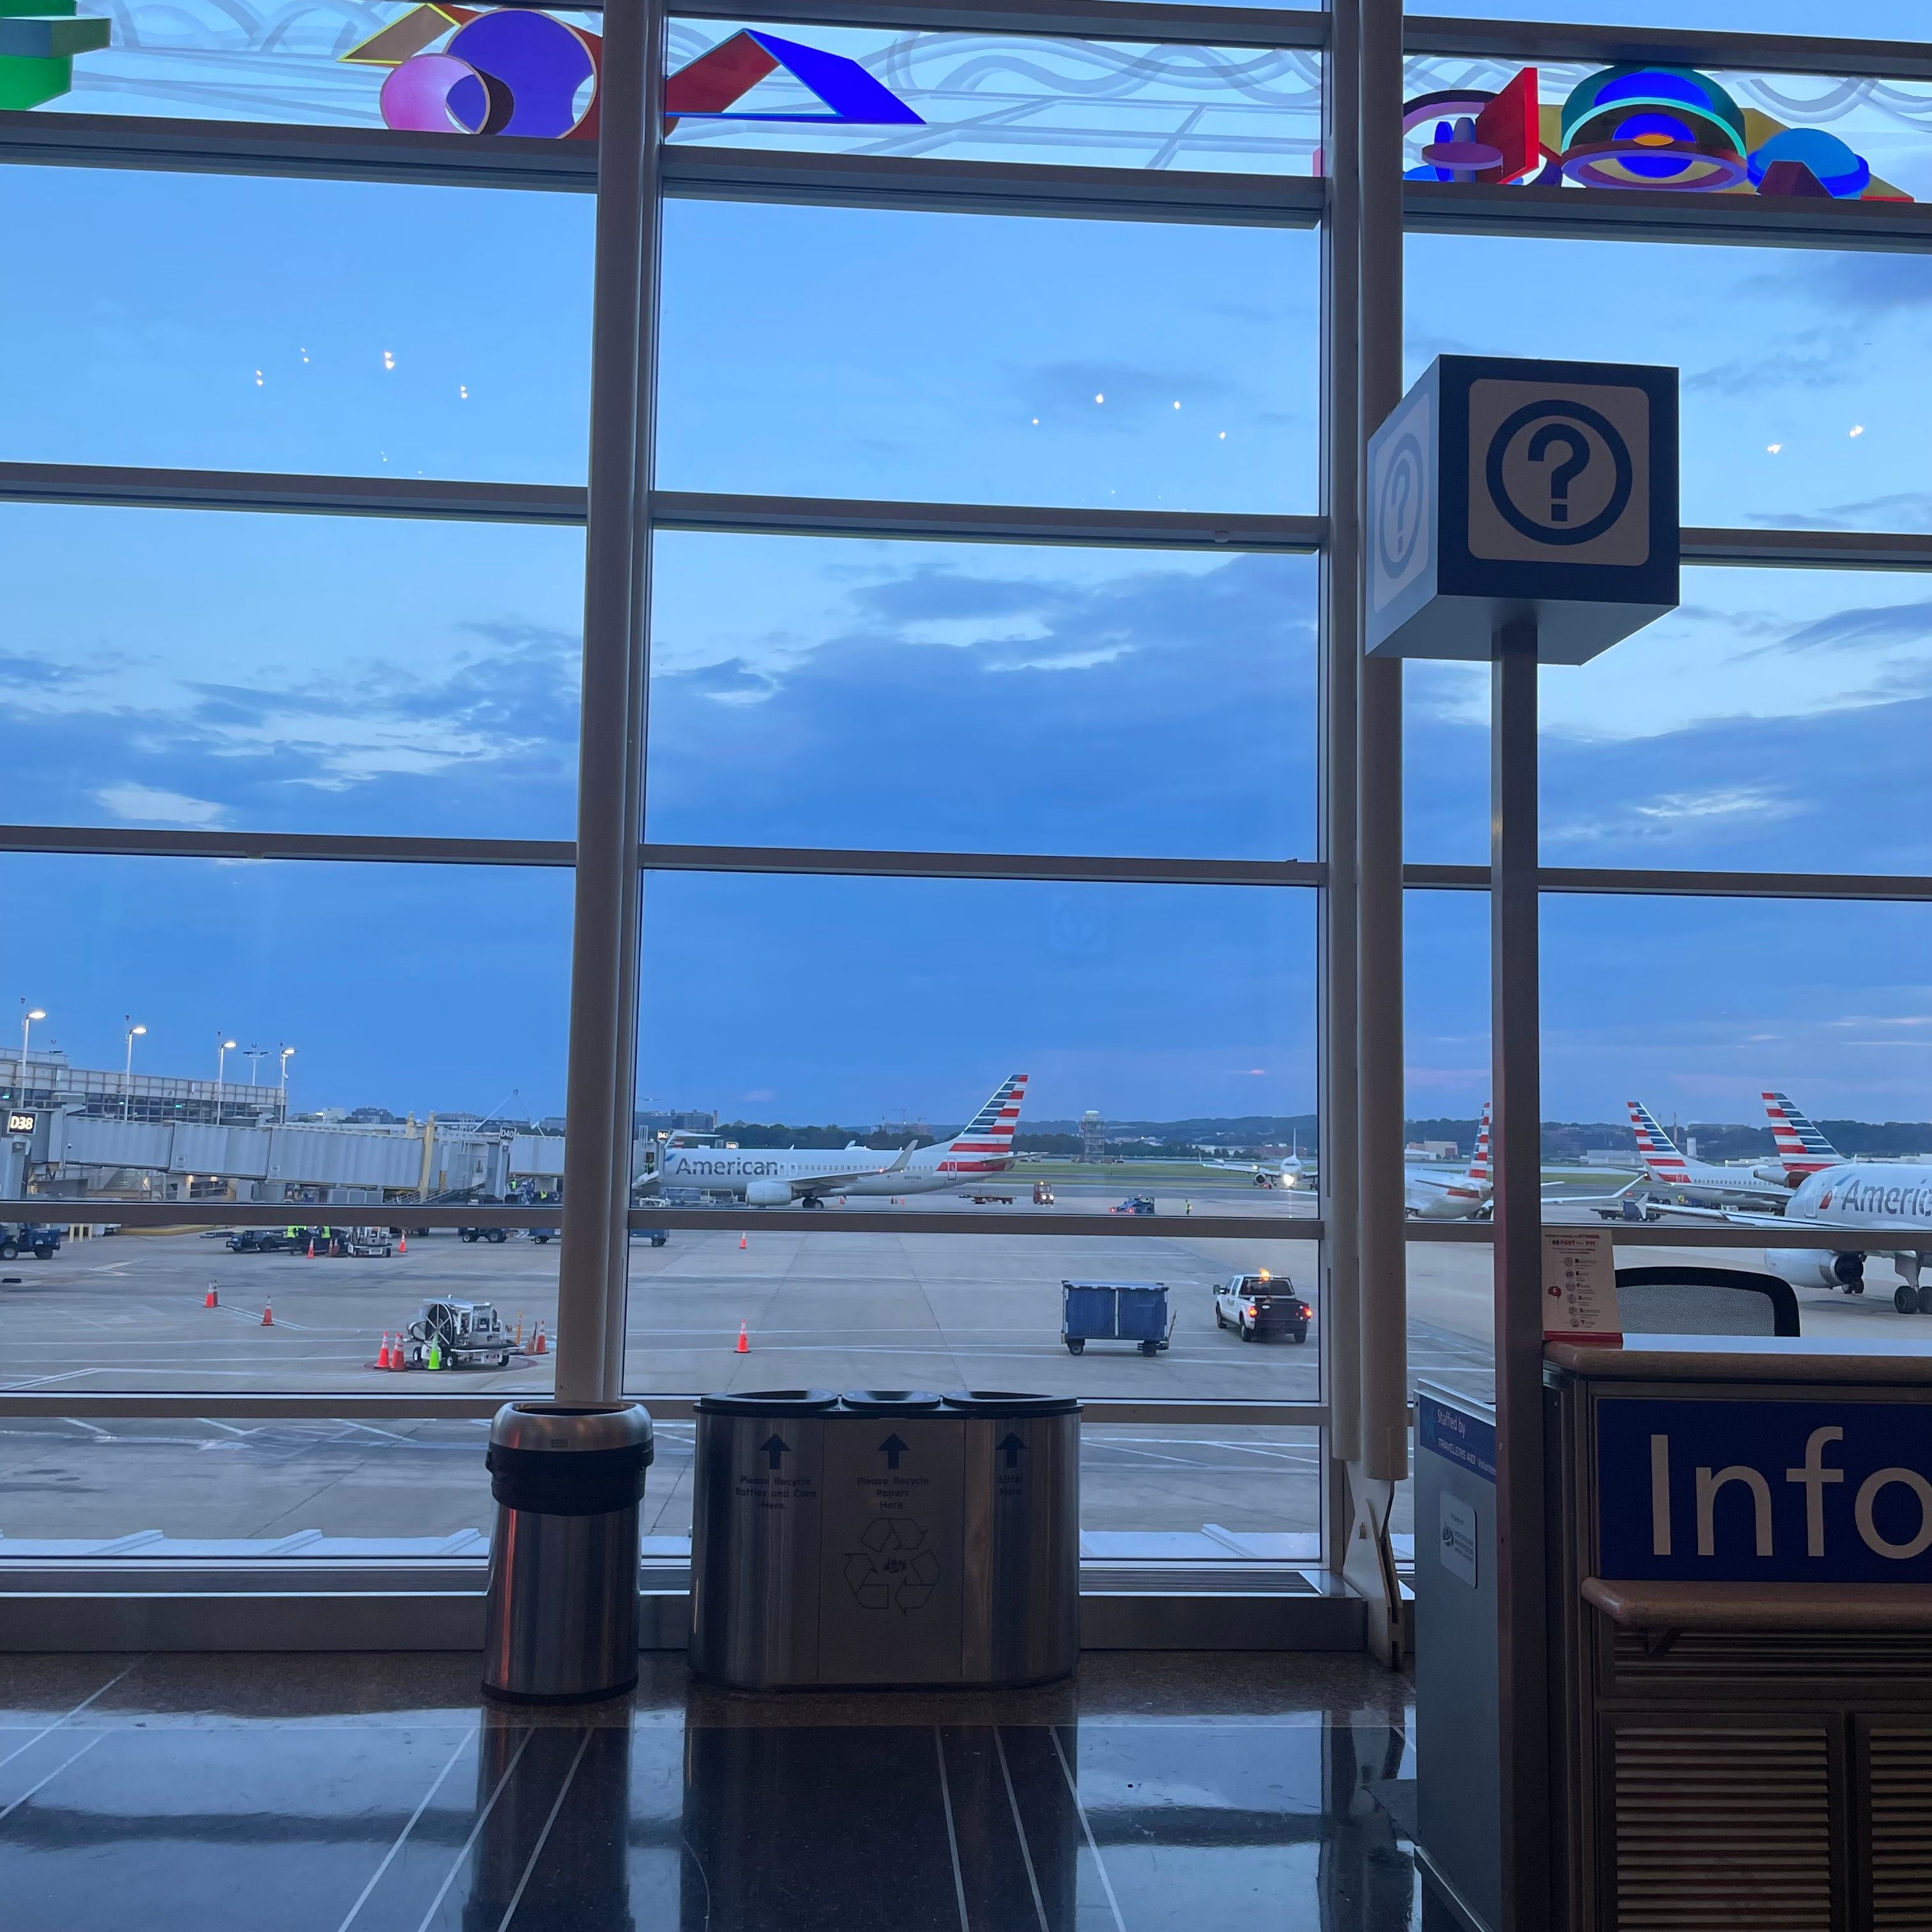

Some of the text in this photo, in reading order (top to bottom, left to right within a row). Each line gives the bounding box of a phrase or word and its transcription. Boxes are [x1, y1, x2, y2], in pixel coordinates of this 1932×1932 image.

[10, 1116, 34, 1130] D38
[501, 1129, 514, 1138] D40
[675, 1157, 778, 1176] American
[1438, 1408, 1466, 1439] Staffed by
[1438, 1438, 1466, 1460] TRAVELERS
[1466, 1452, 1476, 1465] AID
[740, 1475, 812, 1487] Please Recycle
[857, 1476, 930, 1487] Please Recycle
[735, 1487, 817, 1498] Bottles and Cans
[876, 1488, 910, 1499] Papers
[1650, 1425, 1932, 1560] Info
